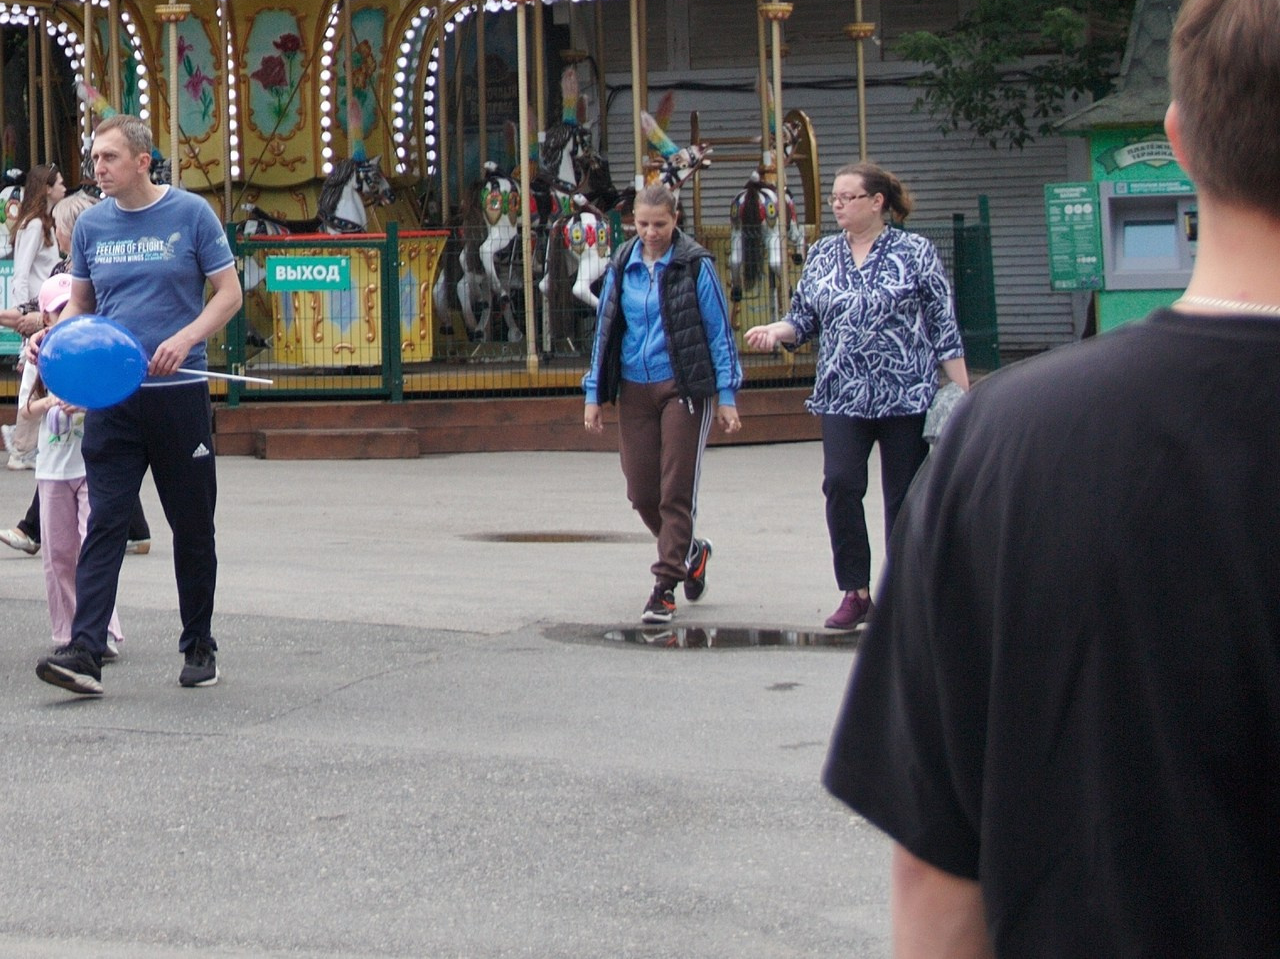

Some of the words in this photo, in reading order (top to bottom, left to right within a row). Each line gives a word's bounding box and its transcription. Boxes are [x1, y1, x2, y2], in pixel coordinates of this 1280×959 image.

[1127, 142, 1172, 155] ПЛАТЁЖН
[96, 243, 125, 255] FEELING
[127, 243, 137, 254] OF
[137, 240, 164, 253] FLIGHT
[275, 264, 340, 283] ВЫХОД
